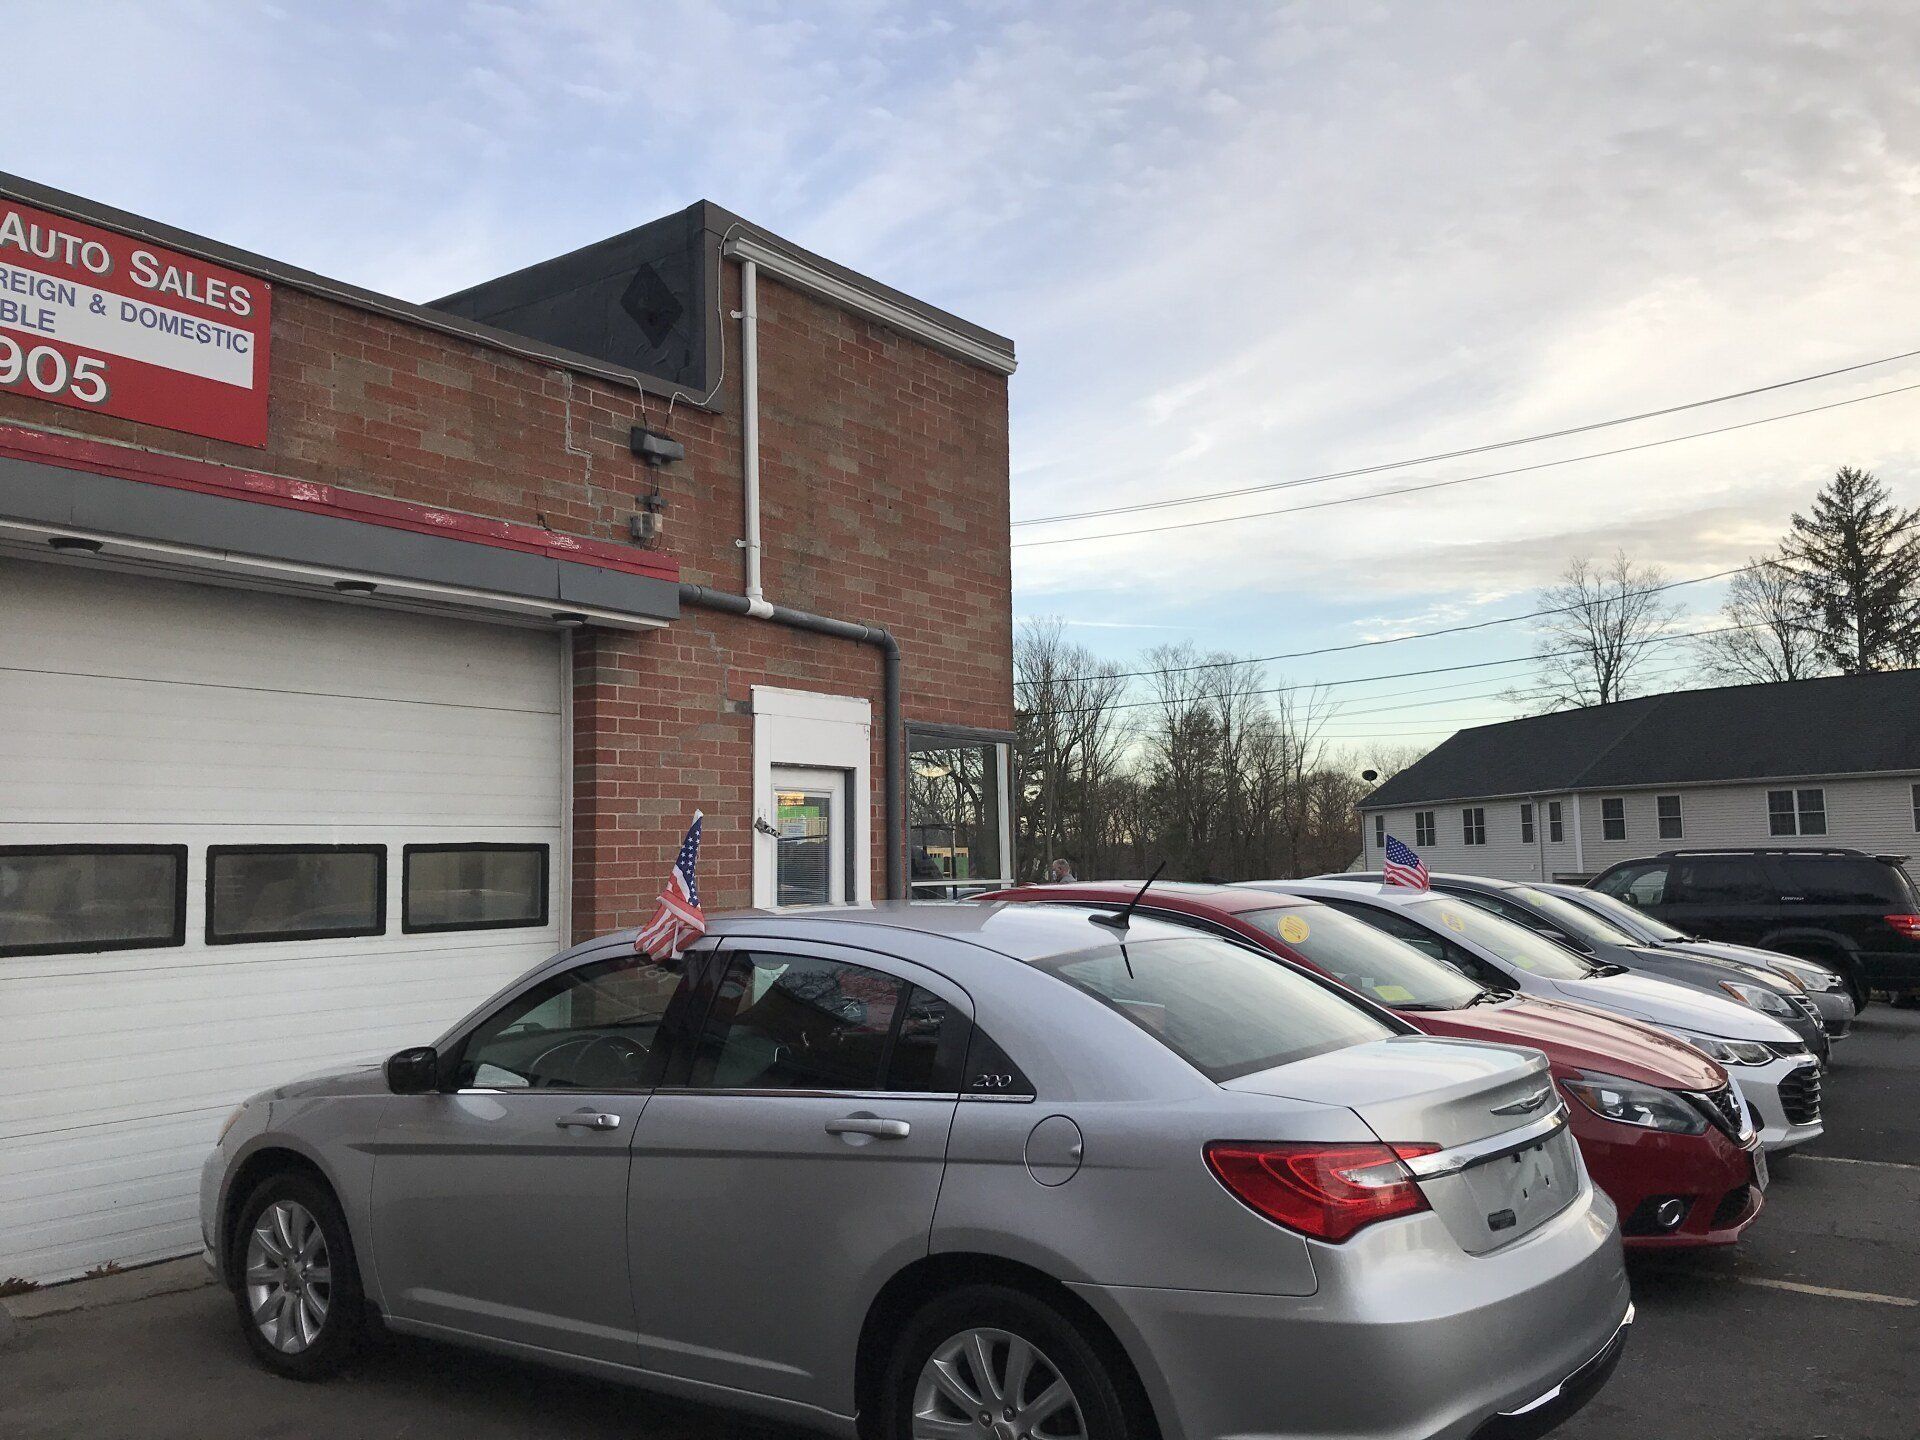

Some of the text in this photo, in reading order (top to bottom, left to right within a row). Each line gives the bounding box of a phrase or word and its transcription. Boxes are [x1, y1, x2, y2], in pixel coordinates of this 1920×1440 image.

[0, 211, 251, 316] AUTO SALES
[89, 293, 107, 315] &
[120, 302, 248, 354] DOMESTIC
